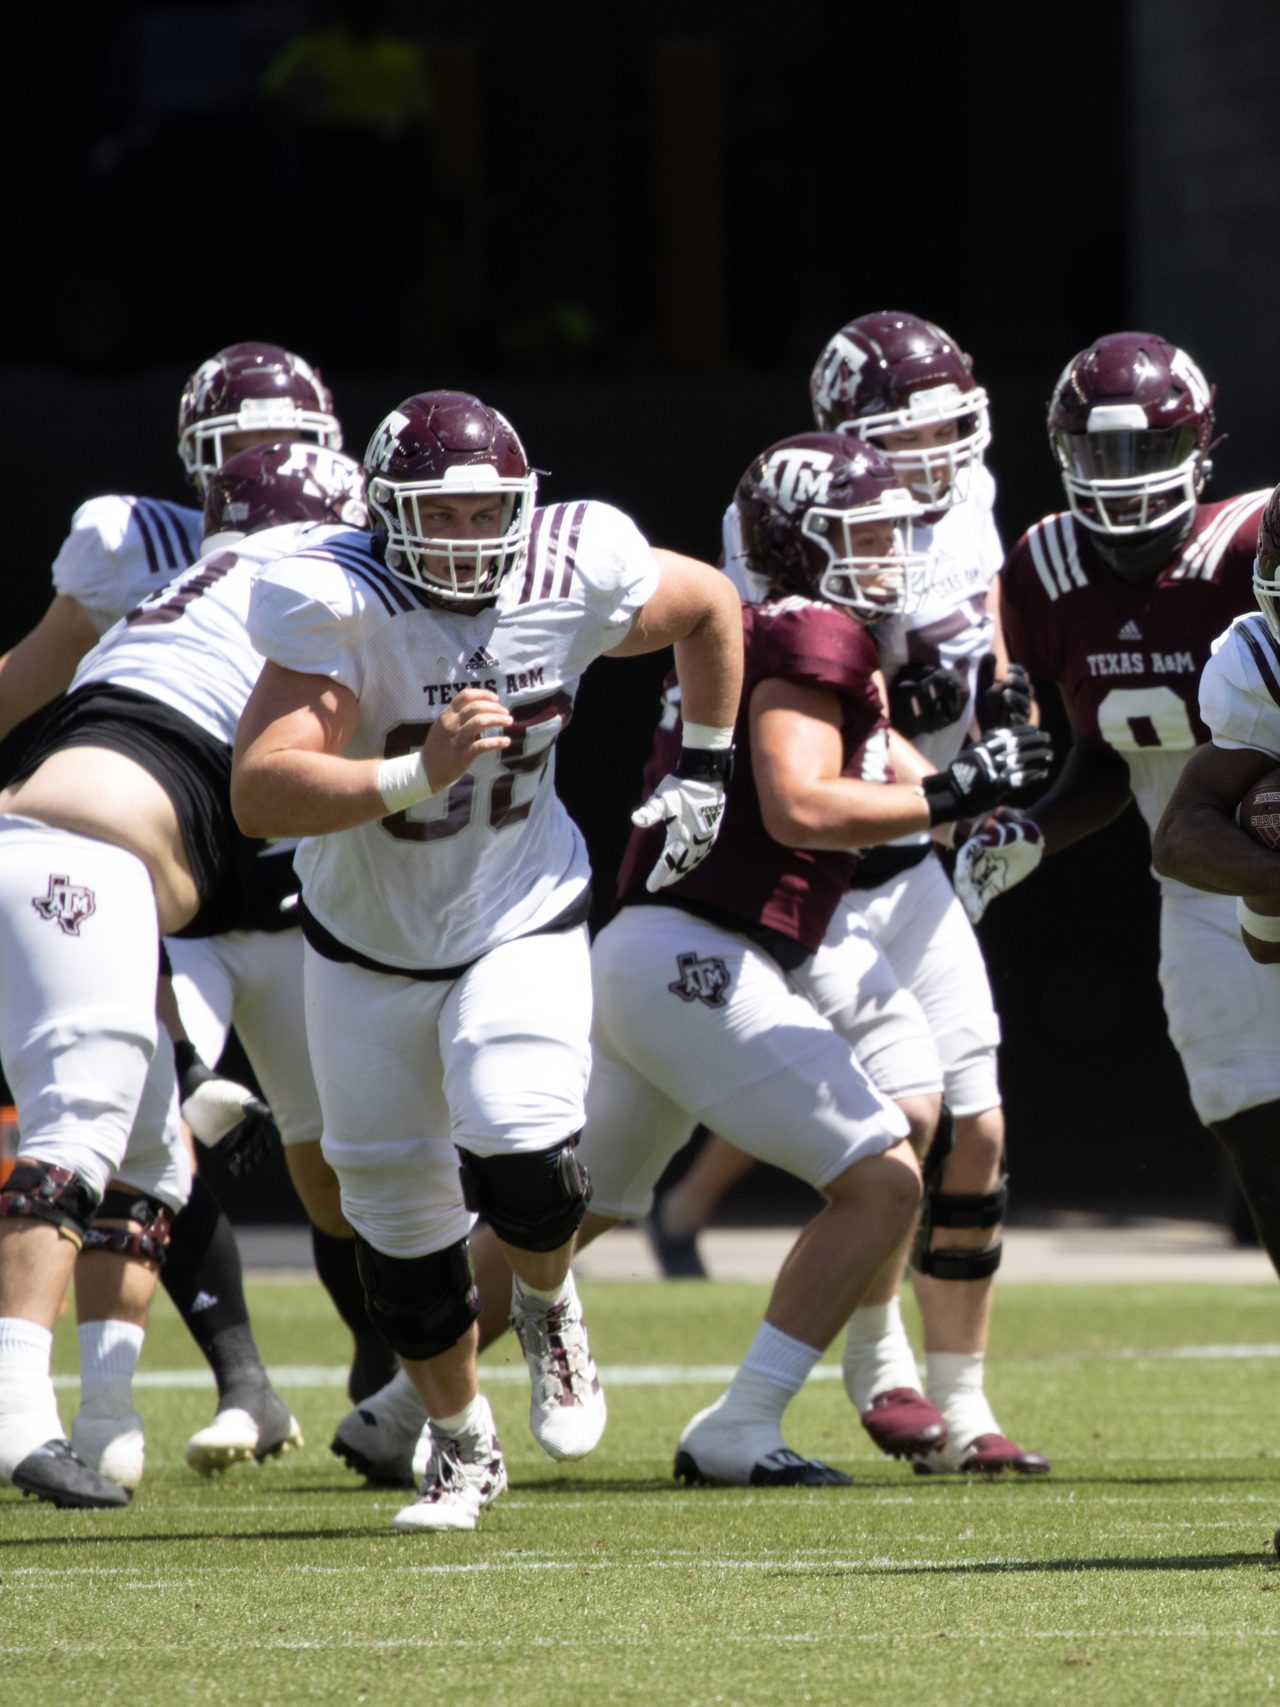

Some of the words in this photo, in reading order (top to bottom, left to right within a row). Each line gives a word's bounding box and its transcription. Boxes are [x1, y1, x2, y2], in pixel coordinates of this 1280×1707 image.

[465, 659, 500, 671] adidas
[1087, 652, 1145, 677] TEXAS
[1150, 651, 1196, 674] A&M
[505, 667, 546, 695] A&M
